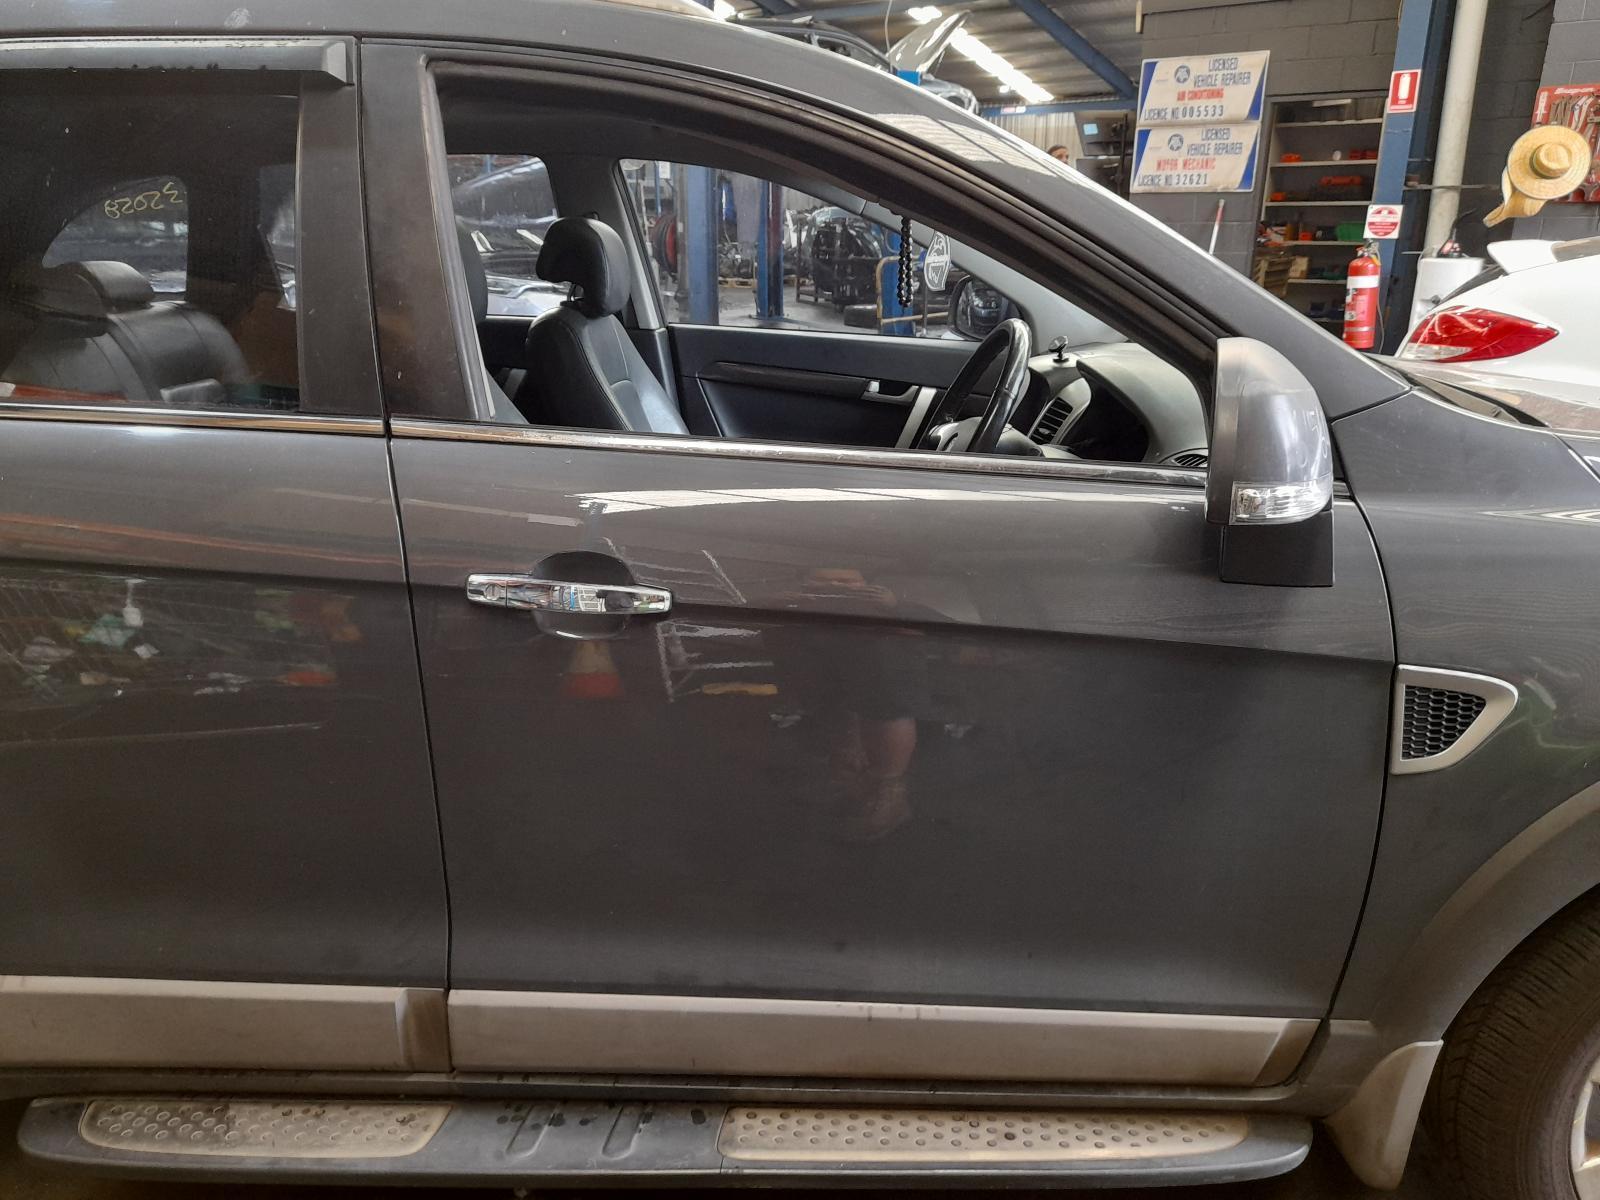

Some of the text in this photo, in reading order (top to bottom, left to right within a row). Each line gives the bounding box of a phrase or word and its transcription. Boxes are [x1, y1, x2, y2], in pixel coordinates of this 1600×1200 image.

[1208, 57, 1239, 71] LICENSED
[1193, 71, 1251, 88] VEHICLE REPAIRER
[1181, 104, 1224, 118] 005533
[1201, 127, 1231, 141] LICENSED
[1187, 142, 1243, 156] VEHICLE REPAIRER
[1183, 157, 1217, 170] MECHANIC
[1175, 172, 1208, 185] 32621
